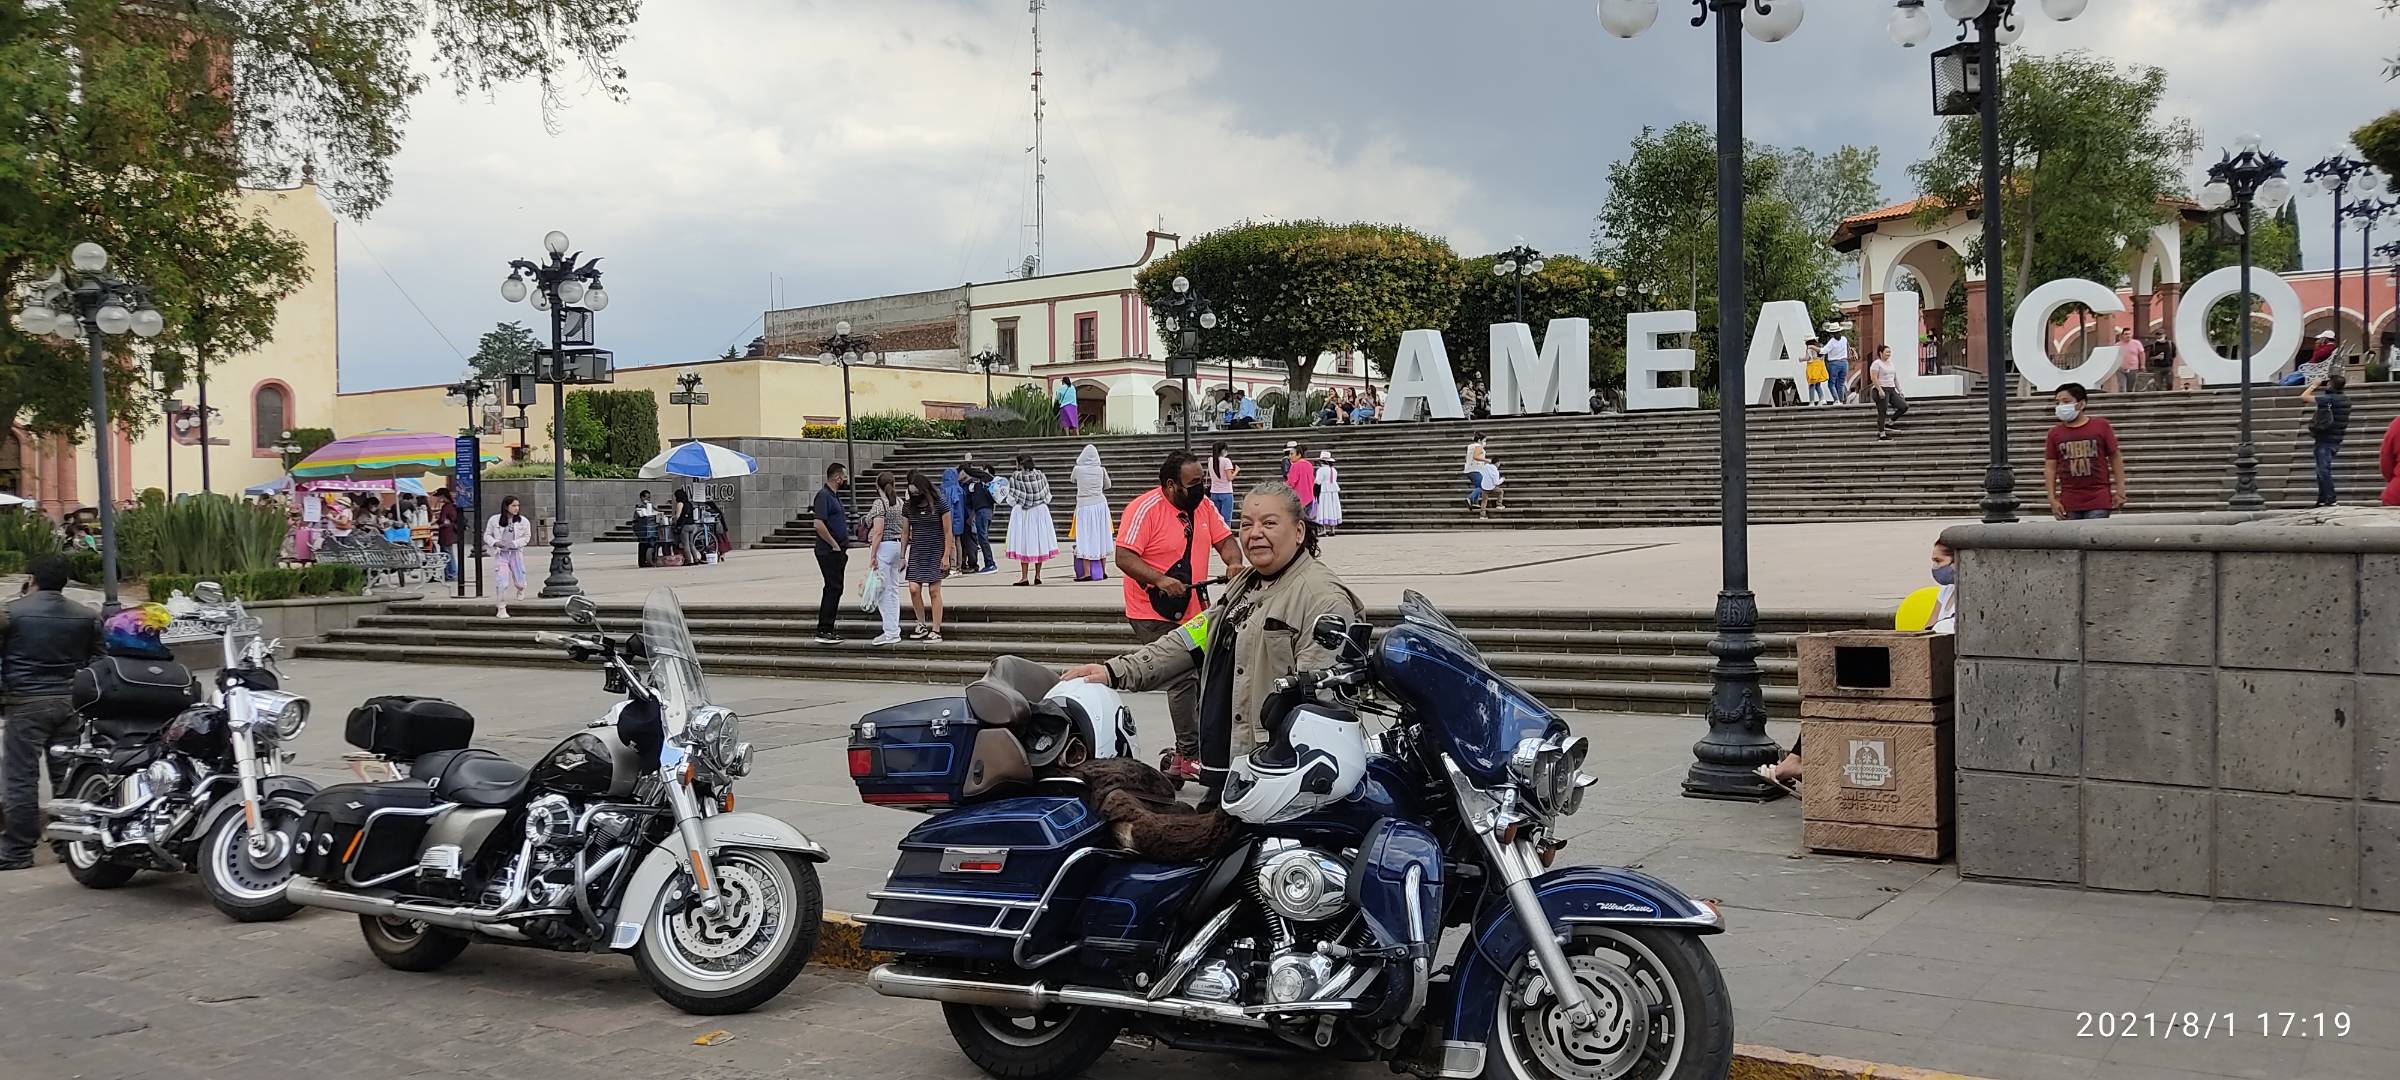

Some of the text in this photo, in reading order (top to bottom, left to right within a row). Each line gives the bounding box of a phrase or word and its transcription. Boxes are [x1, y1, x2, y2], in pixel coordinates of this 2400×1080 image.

[1382, 266, 2304, 422] AMEALCO
[2059, 439, 2098, 459] COBRA
[2070, 458, 2092, 477] KAI
[1836, 789, 1901, 804] AMEALCO
